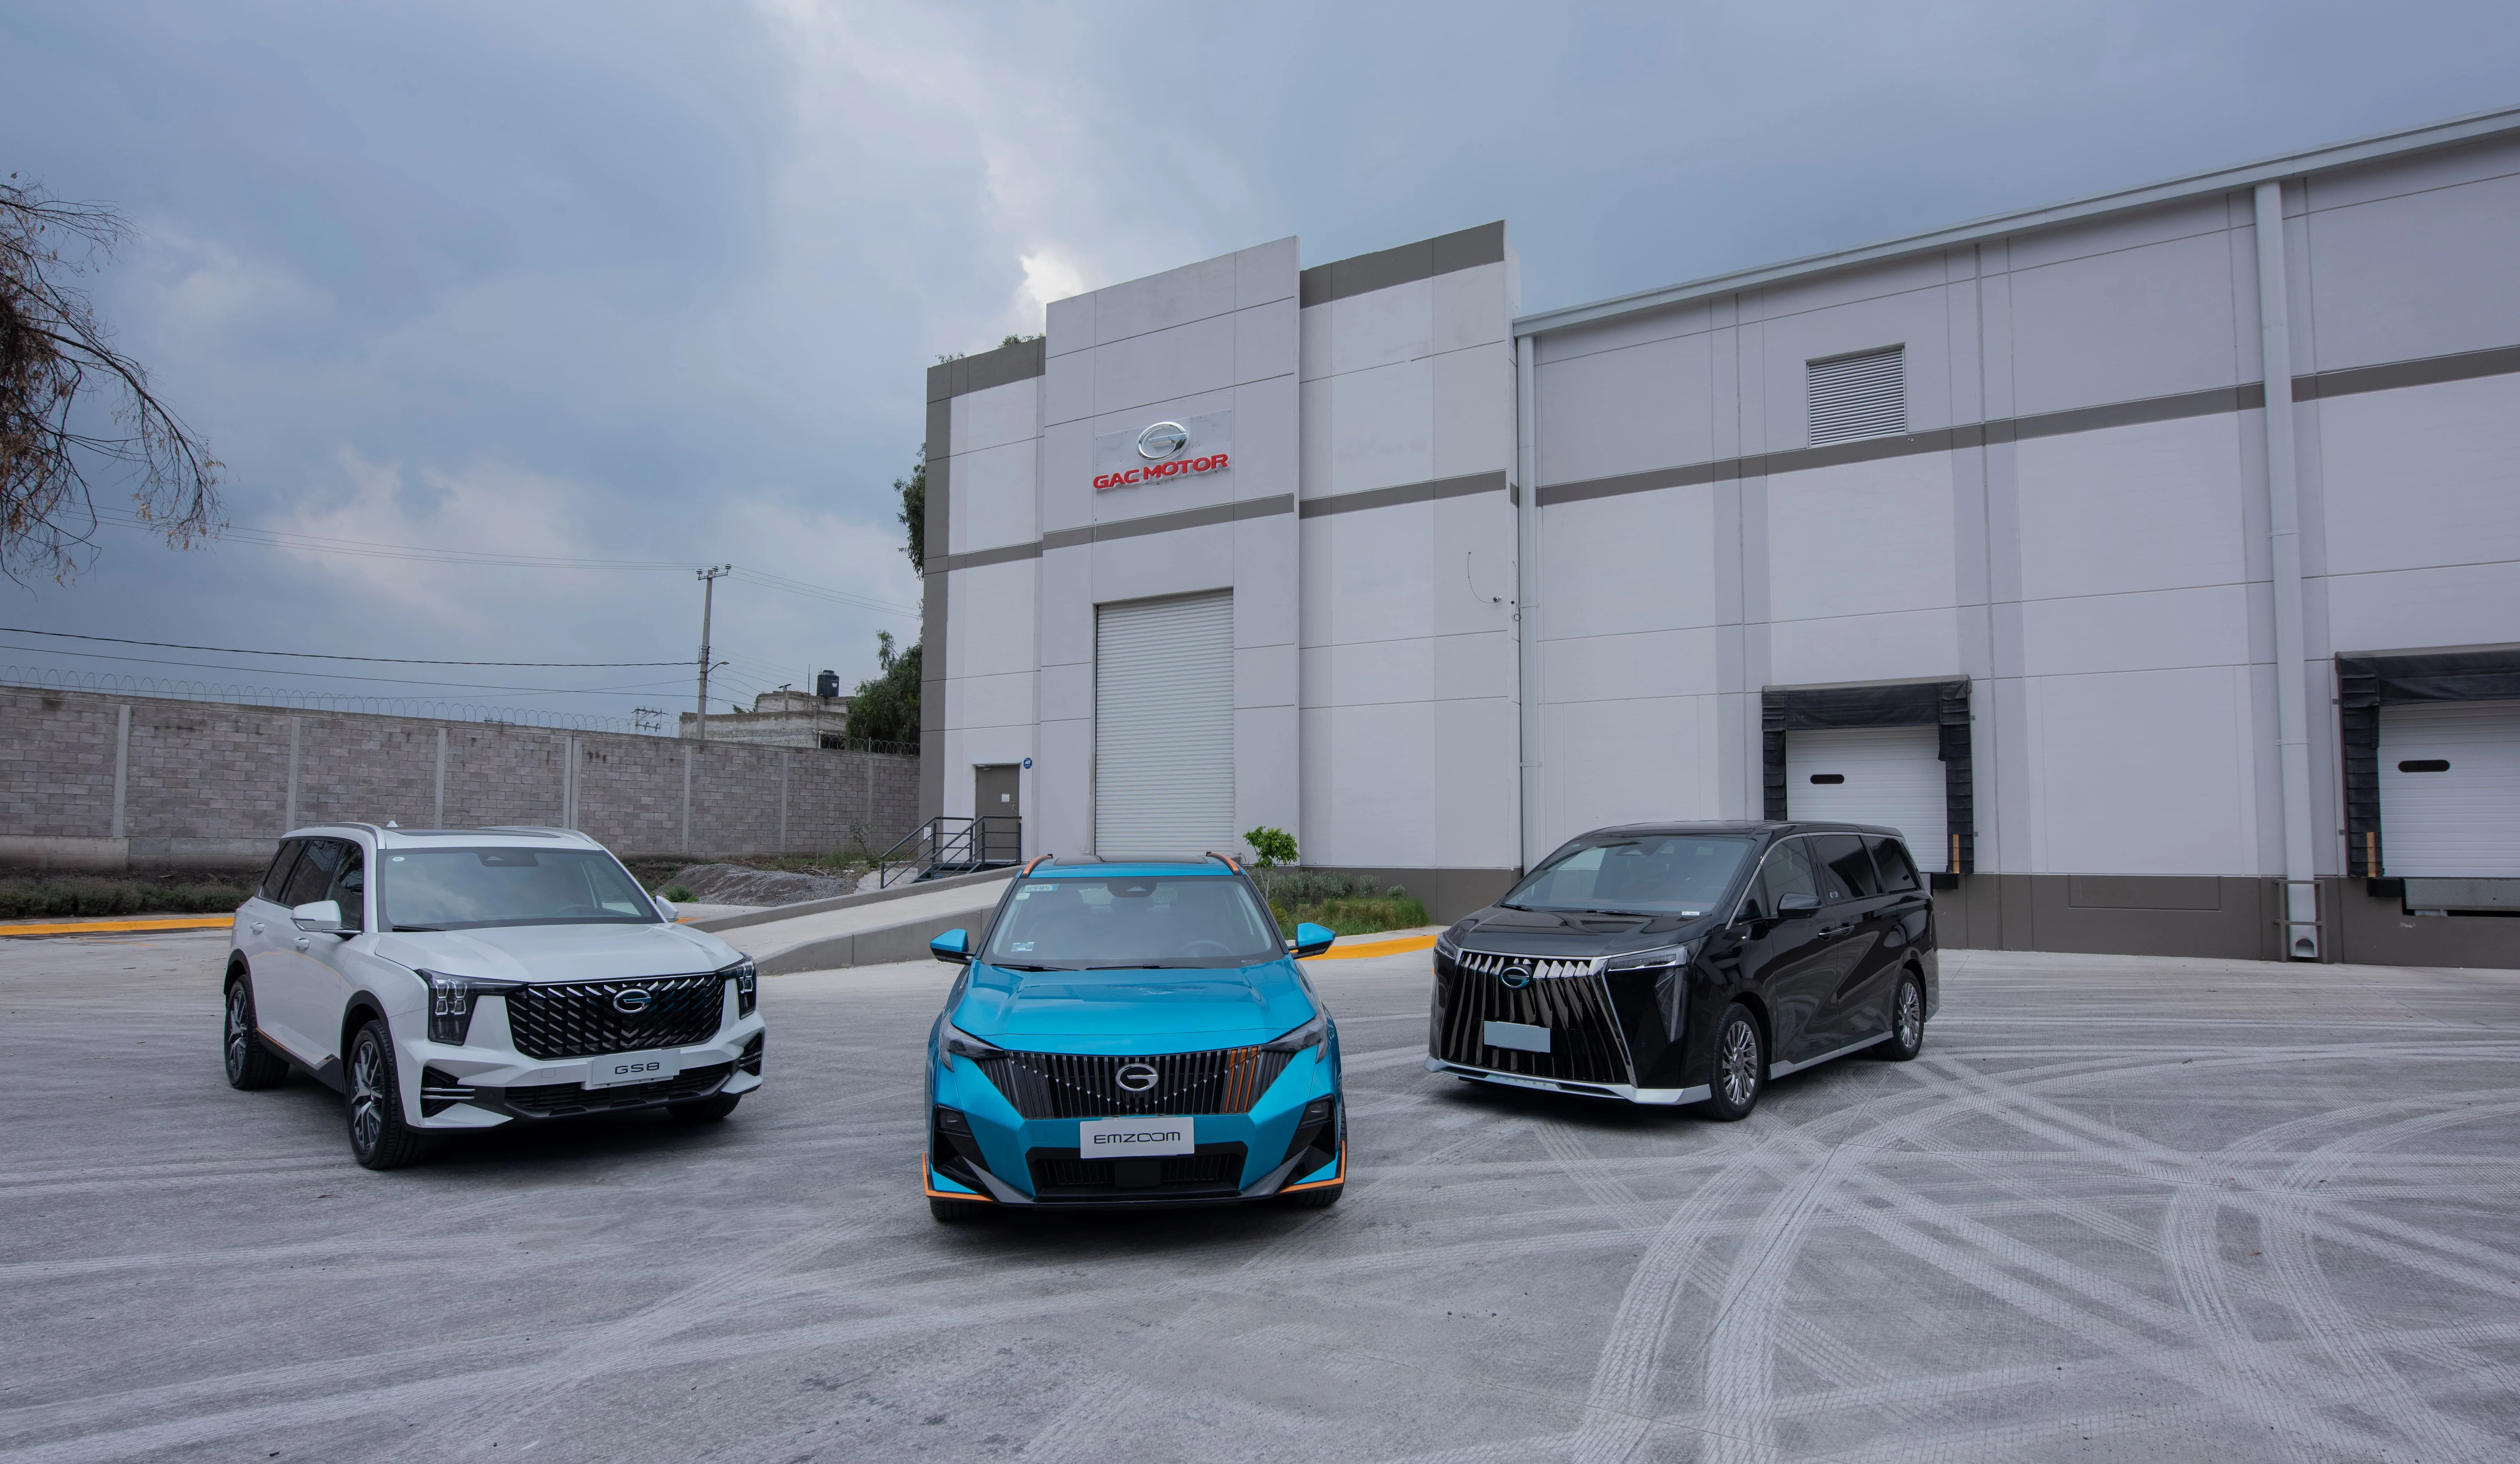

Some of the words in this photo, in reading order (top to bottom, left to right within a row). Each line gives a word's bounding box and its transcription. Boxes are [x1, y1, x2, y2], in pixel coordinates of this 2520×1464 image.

[1093, 469, 1139, 489] GAC
[1143, 453, 1229, 480] MOTOR
[615, 1062, 660, 1074] GS8
[1496, 1076, 1547, 1086] MASTER
[1094, 1132, 1180, 1144] EMZOOM
